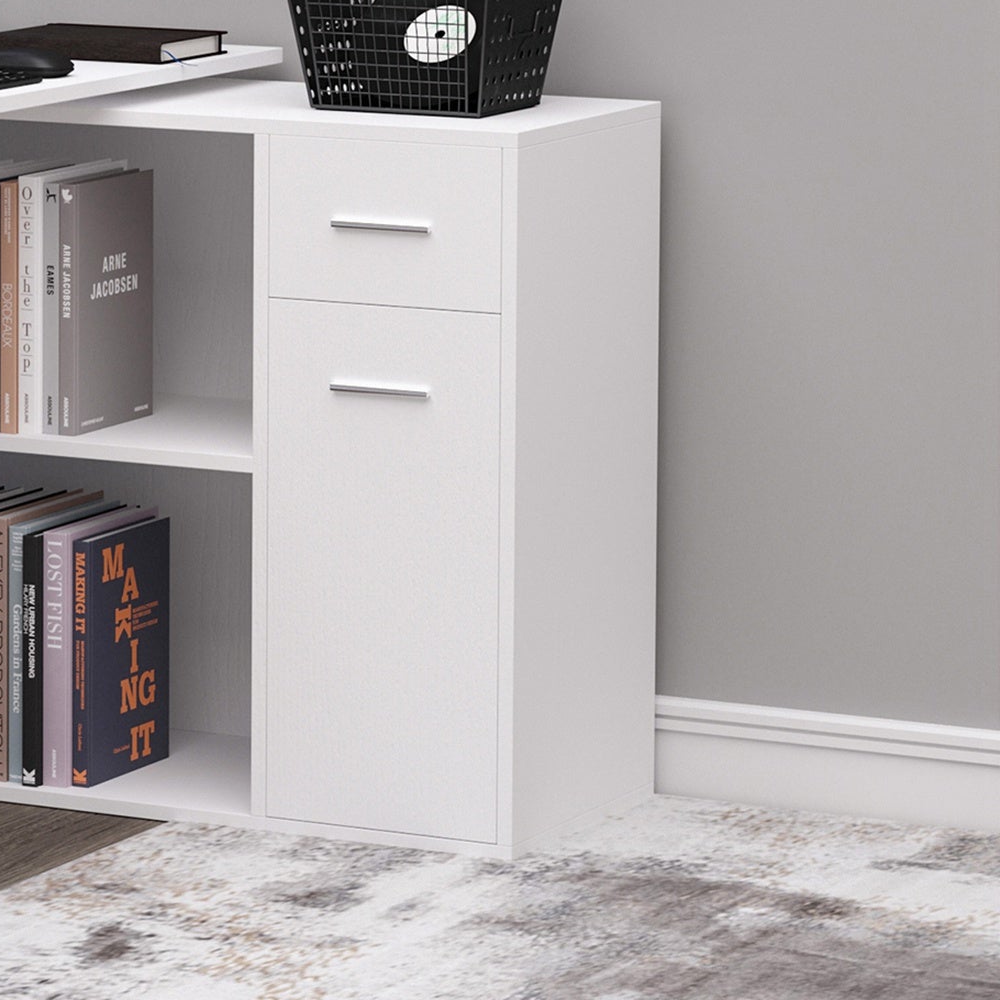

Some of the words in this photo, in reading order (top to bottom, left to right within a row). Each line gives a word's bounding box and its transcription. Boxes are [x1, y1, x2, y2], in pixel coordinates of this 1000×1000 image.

[46, 265, 55, 296] EAMES
[102, 252, 127, 273] ARNE
[90, 274, 139, 300] JACOBSEN
[2, 284, 12, 348] BORDEAUX
[48, 541, 63, 601] LOST
[76, 552, 85, 614] MAKING
[13, 604, 22, 654] Gardens
[48, 602, 63, 649] FISH
[76, 618, 85, 634] IT
[14, 657, 22, 668] in
[13, 672, 22, 714] France
[130, 720, 155, 761] IT
